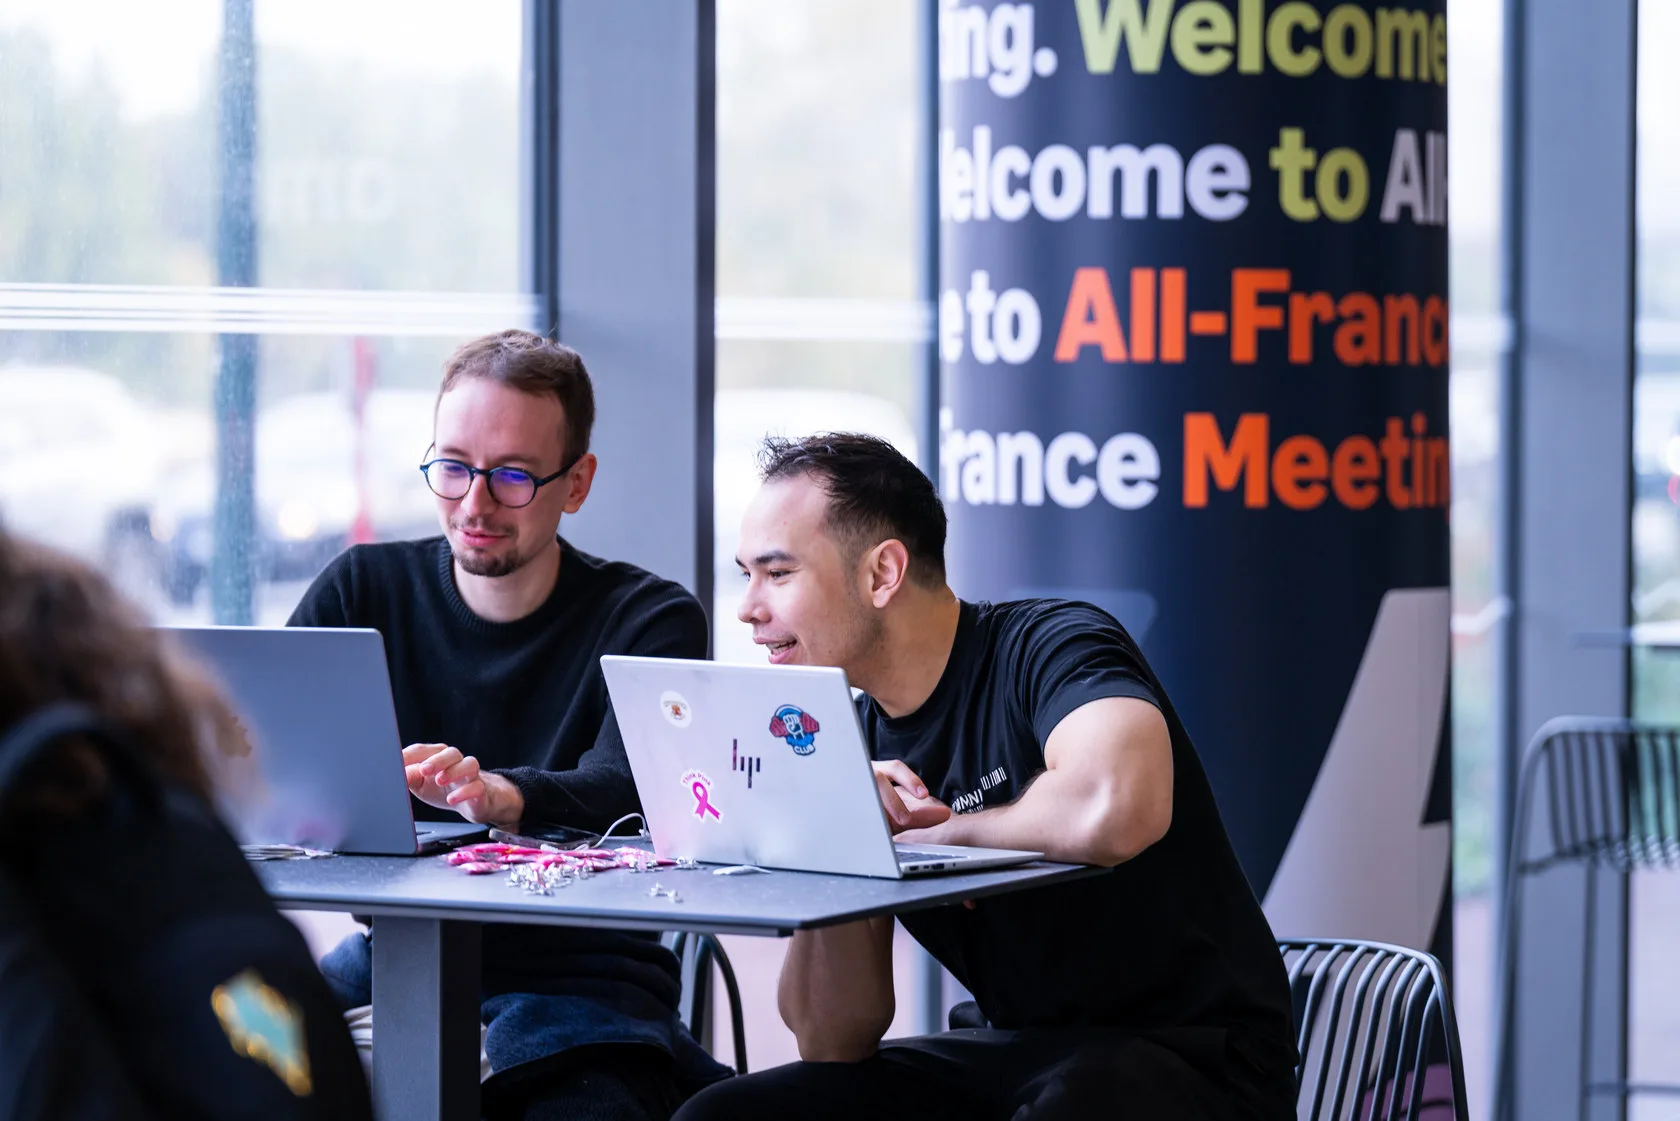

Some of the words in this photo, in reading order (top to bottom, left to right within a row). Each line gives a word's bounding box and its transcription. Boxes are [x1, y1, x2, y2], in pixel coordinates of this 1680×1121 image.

[1075, 0, 1447, 86] Welcome
[939, 124, 1251, 223] elcome
[1269, 127, 1370, 222] to
[1379, 127, 1448, 226] All
[966, 269, 1041, 364] to
[1054, 267, 1449, 367] All-Franc
[1182, 410, 1449, 511] Meetin
